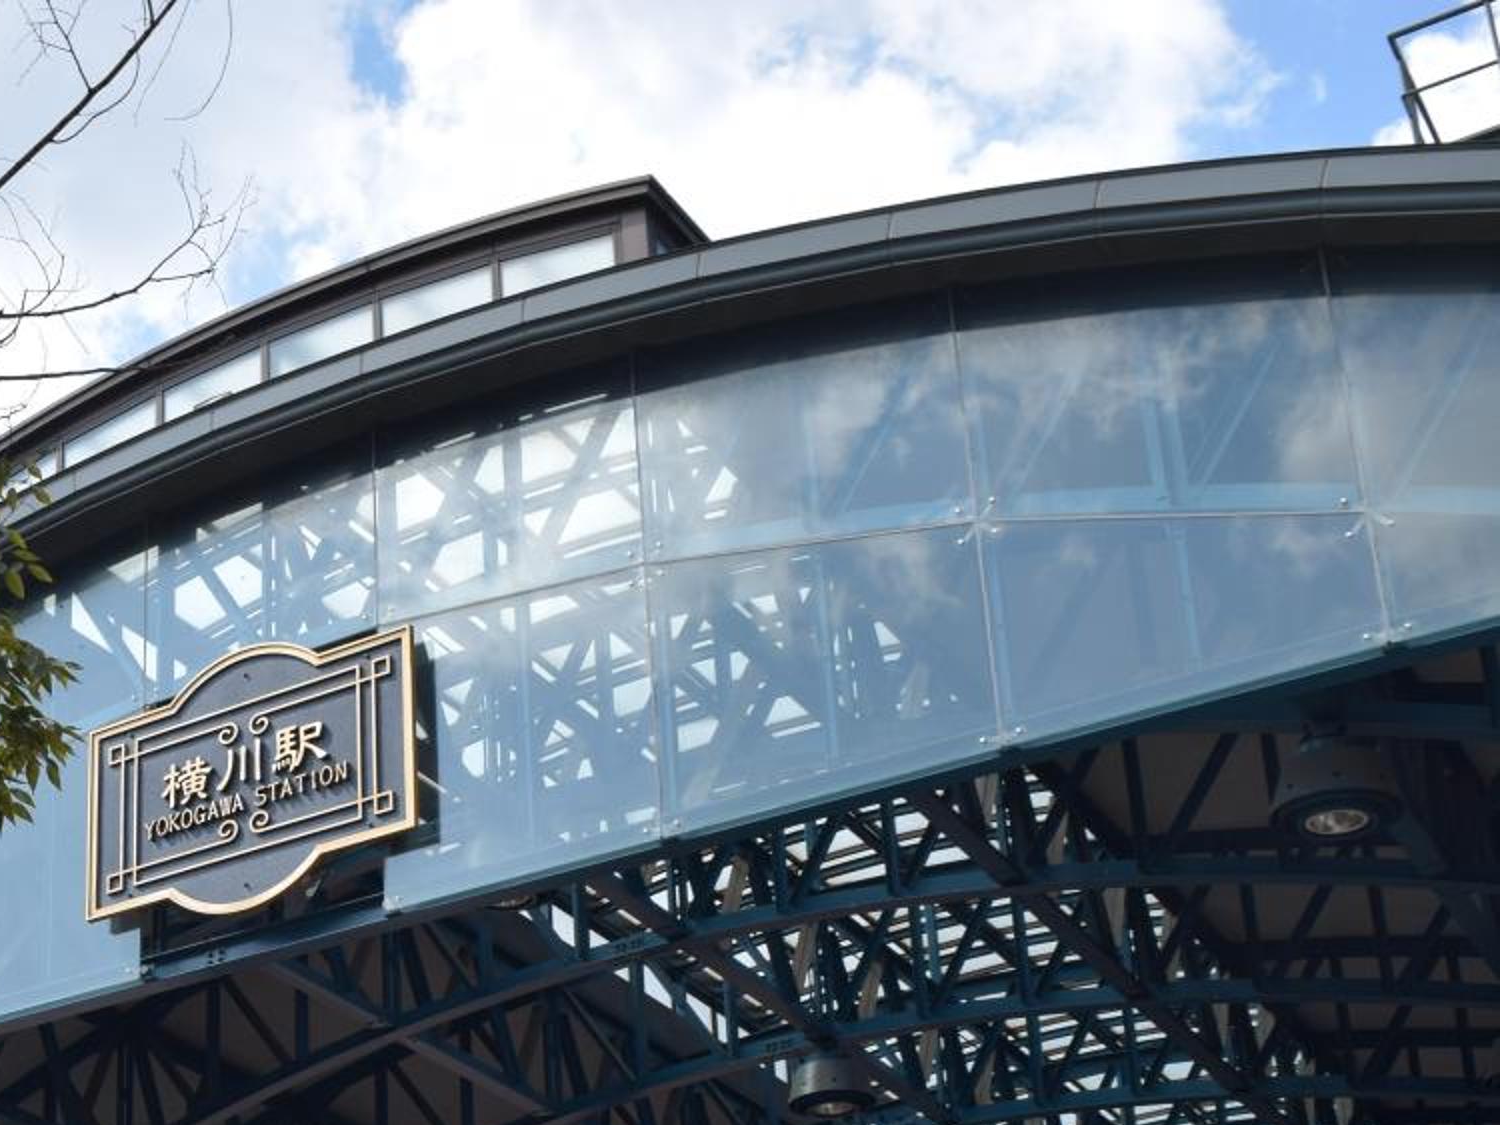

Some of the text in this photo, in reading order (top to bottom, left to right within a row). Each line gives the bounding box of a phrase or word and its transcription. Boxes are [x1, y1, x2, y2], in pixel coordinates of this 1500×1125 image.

[144, 760, 348, 841] YOKOGAWA STATION
[161, 721, 327, 809] 横川駅
